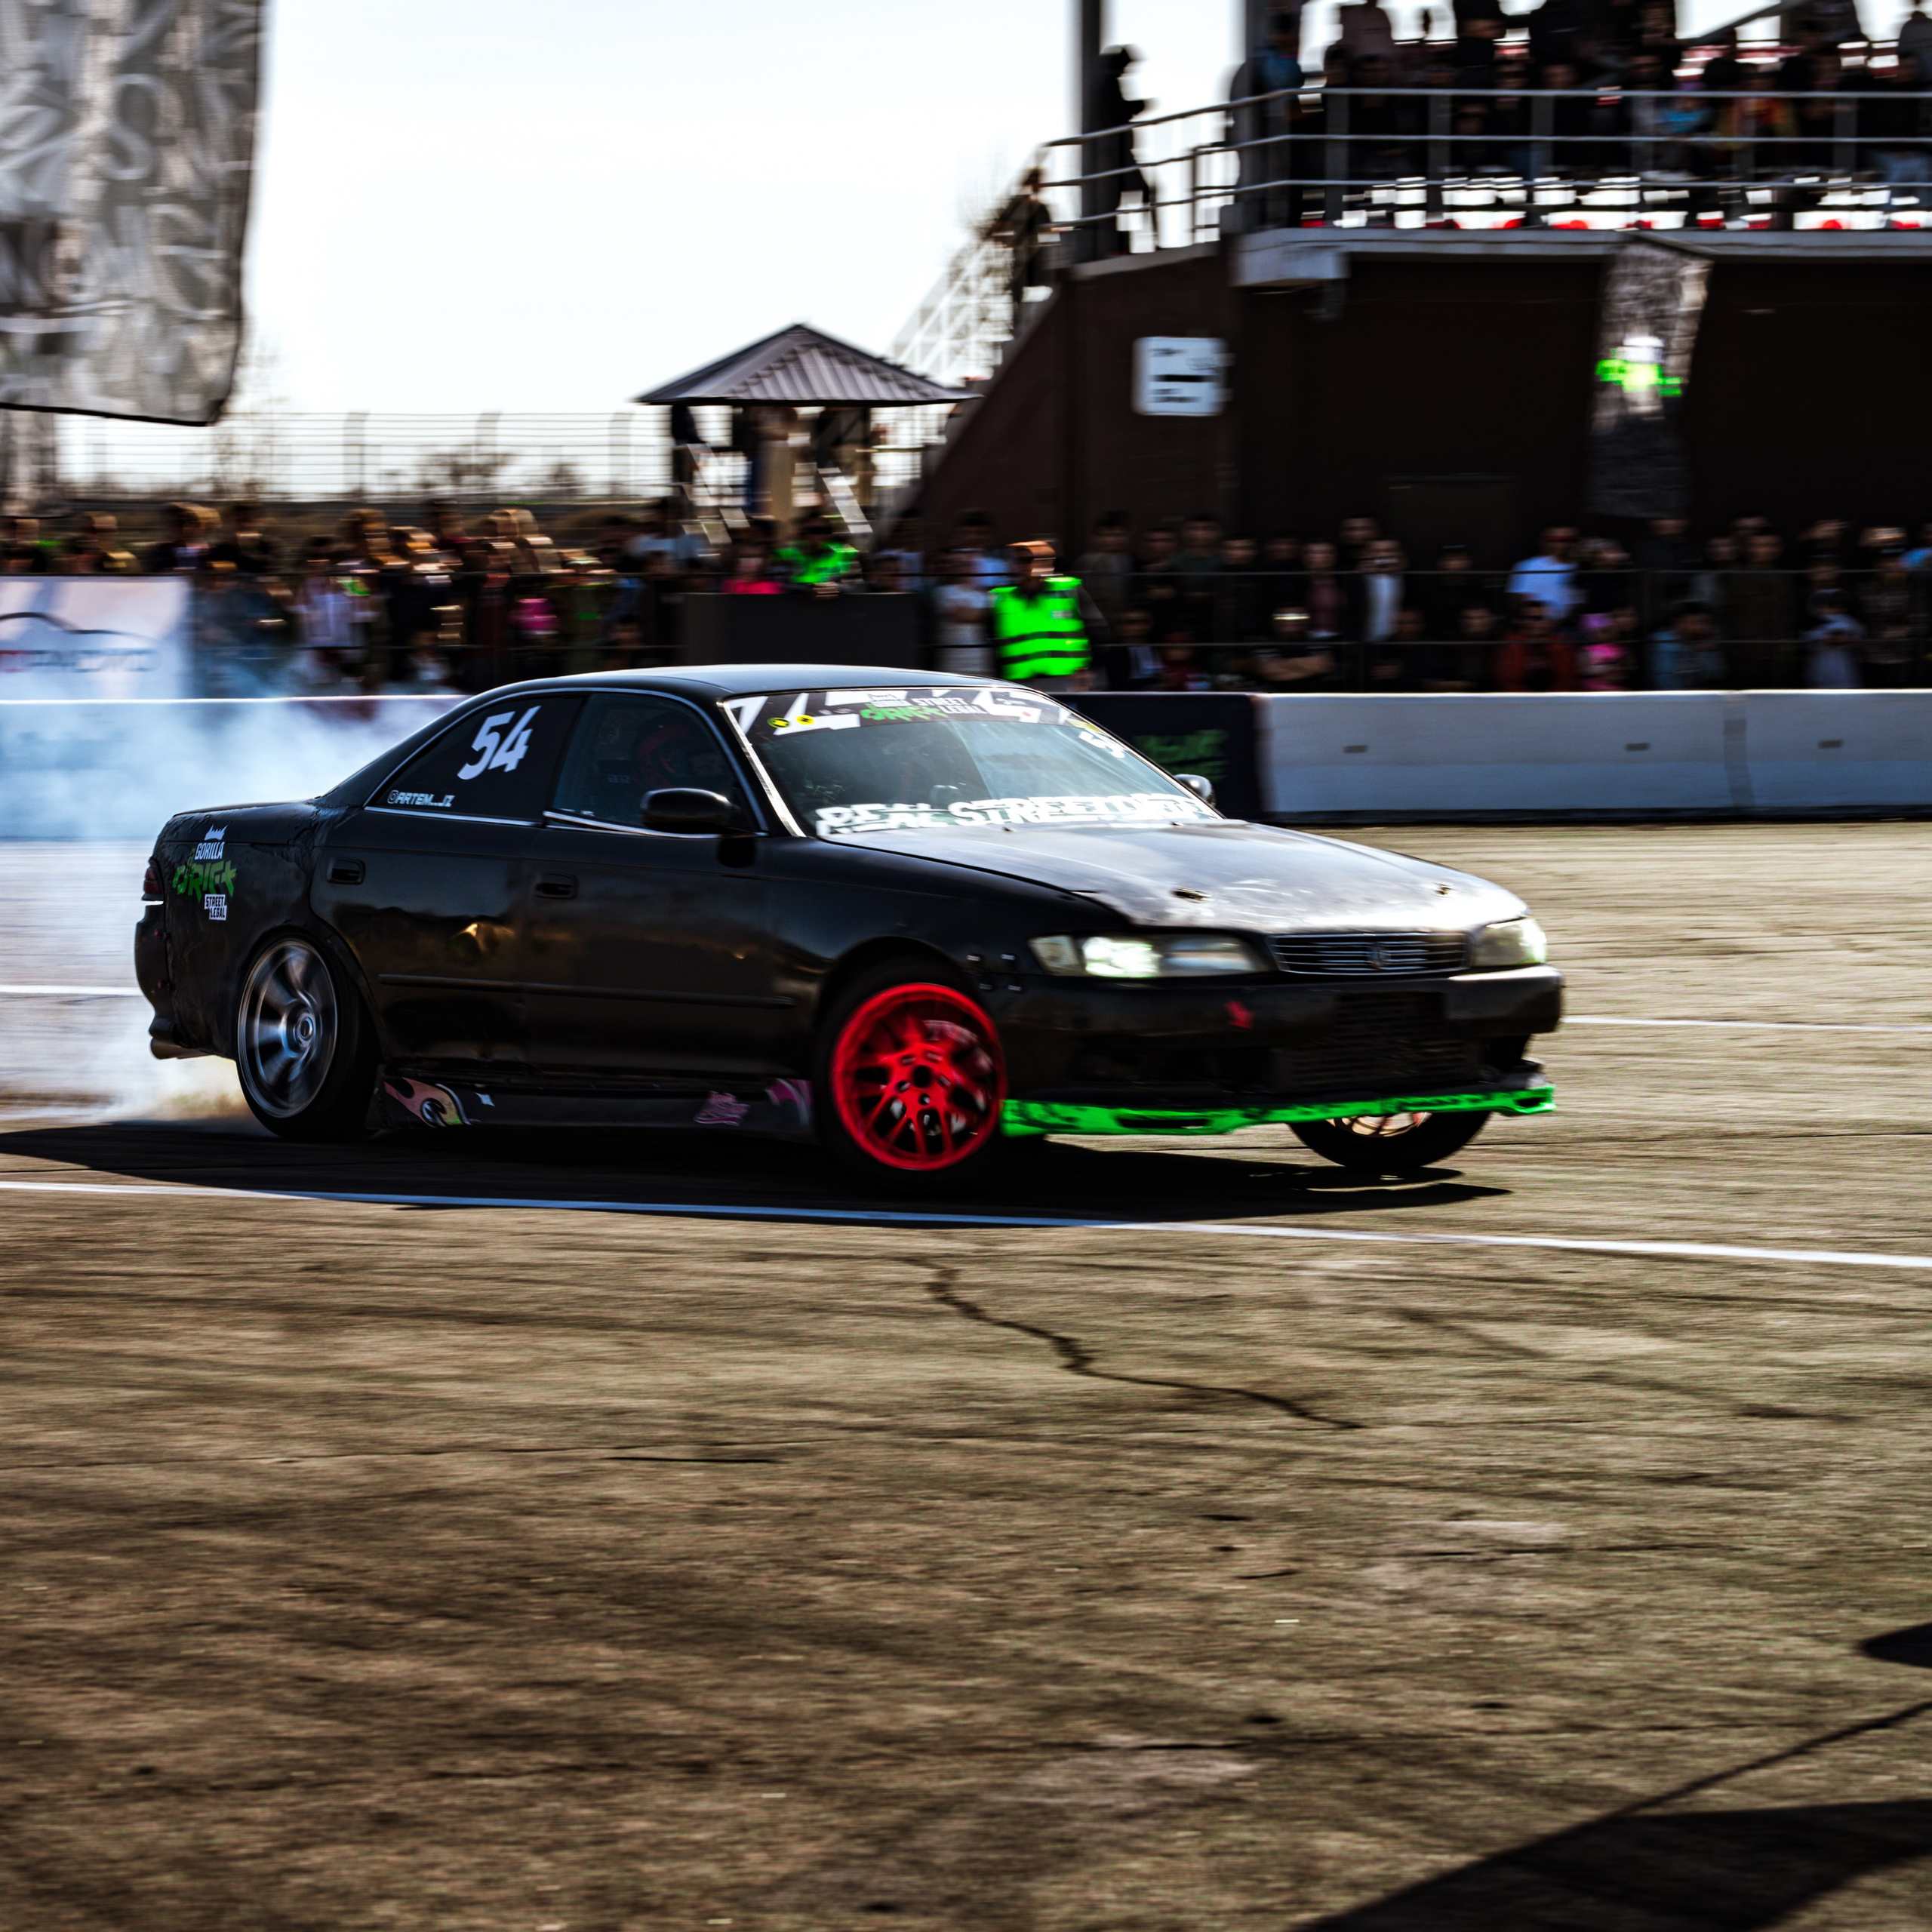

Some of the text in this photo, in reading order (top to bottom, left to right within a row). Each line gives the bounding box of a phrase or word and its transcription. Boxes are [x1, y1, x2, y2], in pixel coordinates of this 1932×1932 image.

[457, 705, 542, 780] 54
[194, 841, 225, 860] GORILLA
[205, 896, 224, 908] STREET
[210, 906, 225, 918] LEGAL
